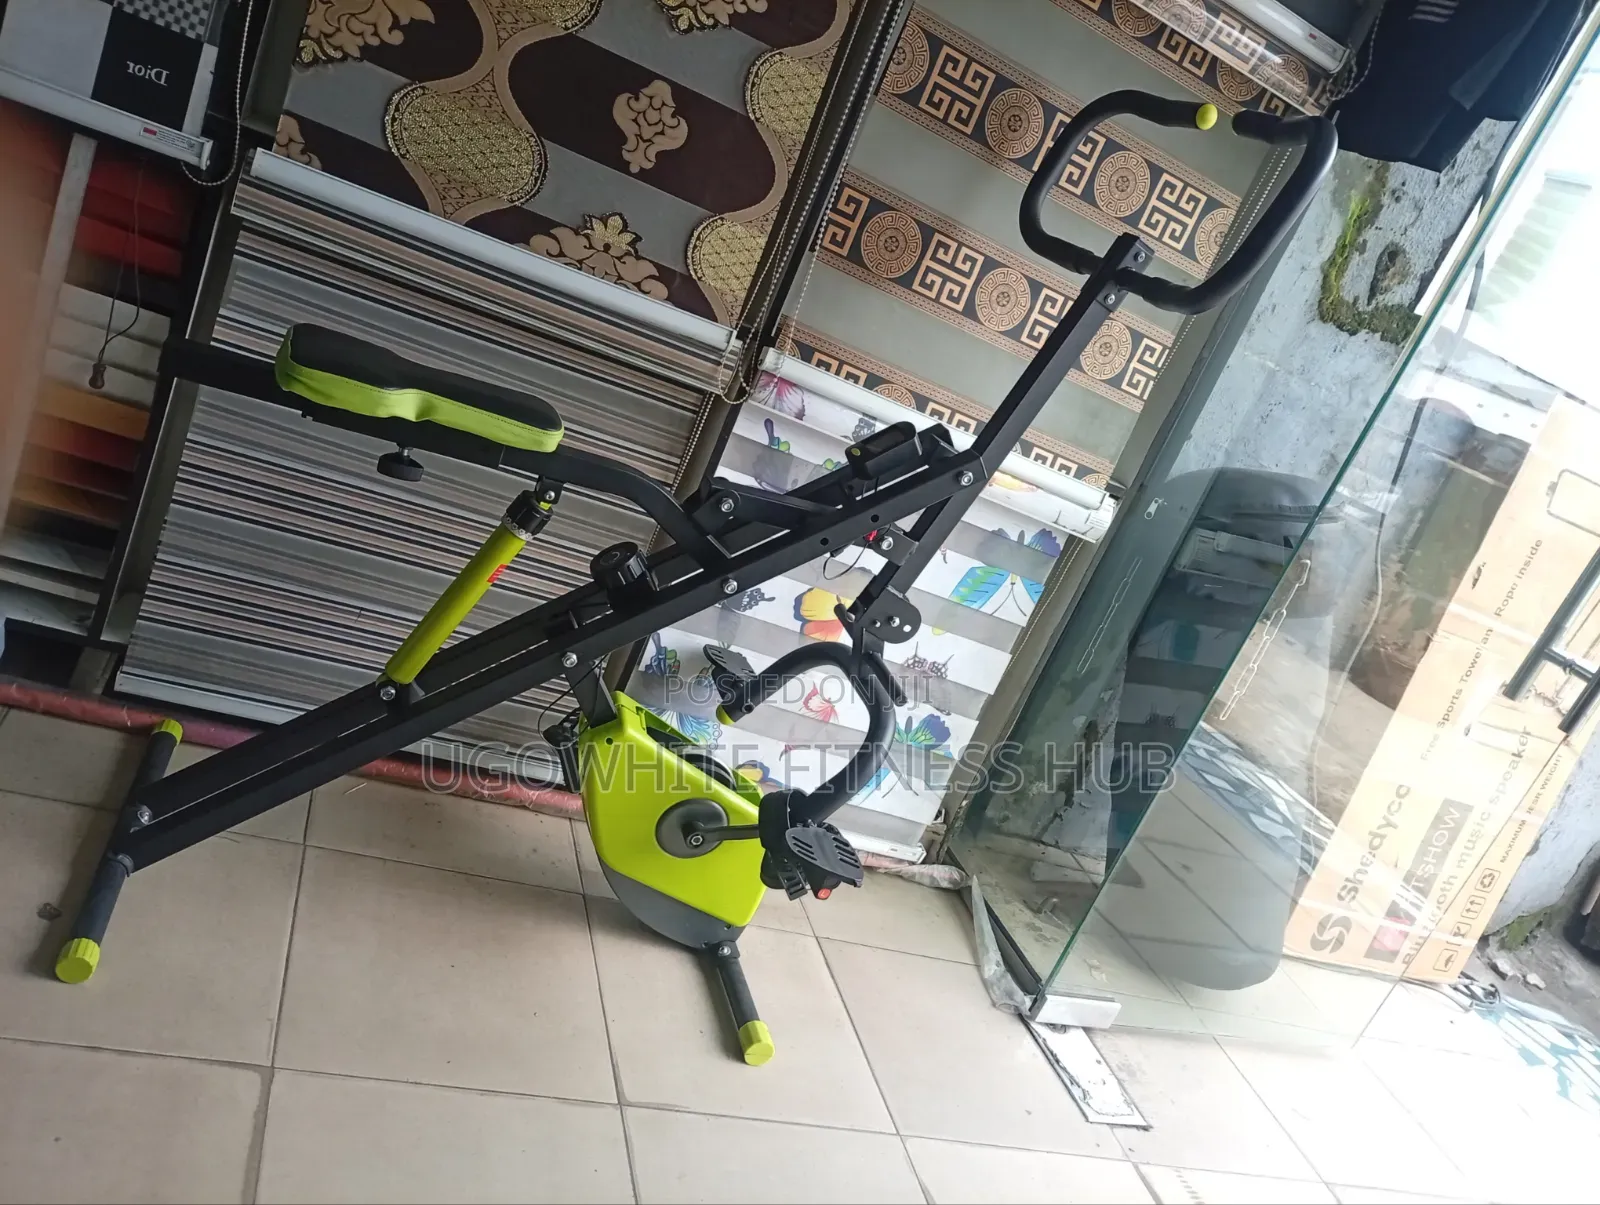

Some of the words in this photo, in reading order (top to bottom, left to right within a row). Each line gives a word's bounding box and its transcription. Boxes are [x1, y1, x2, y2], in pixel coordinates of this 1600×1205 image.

[1437, 688, 1463, 728] Sports
[1458, 646, 1483, 684] Towel
[1494, 582, 1518, 617] Rope
[1515, 539, 1543, 579] inside
[1456, 811, 1492, 869] music
[1489, 725, 1532, 806] speaker
[1500, 819, 1527, 863] MAXIMUM
[1540, 753, 1563, 791] WEIGHT
